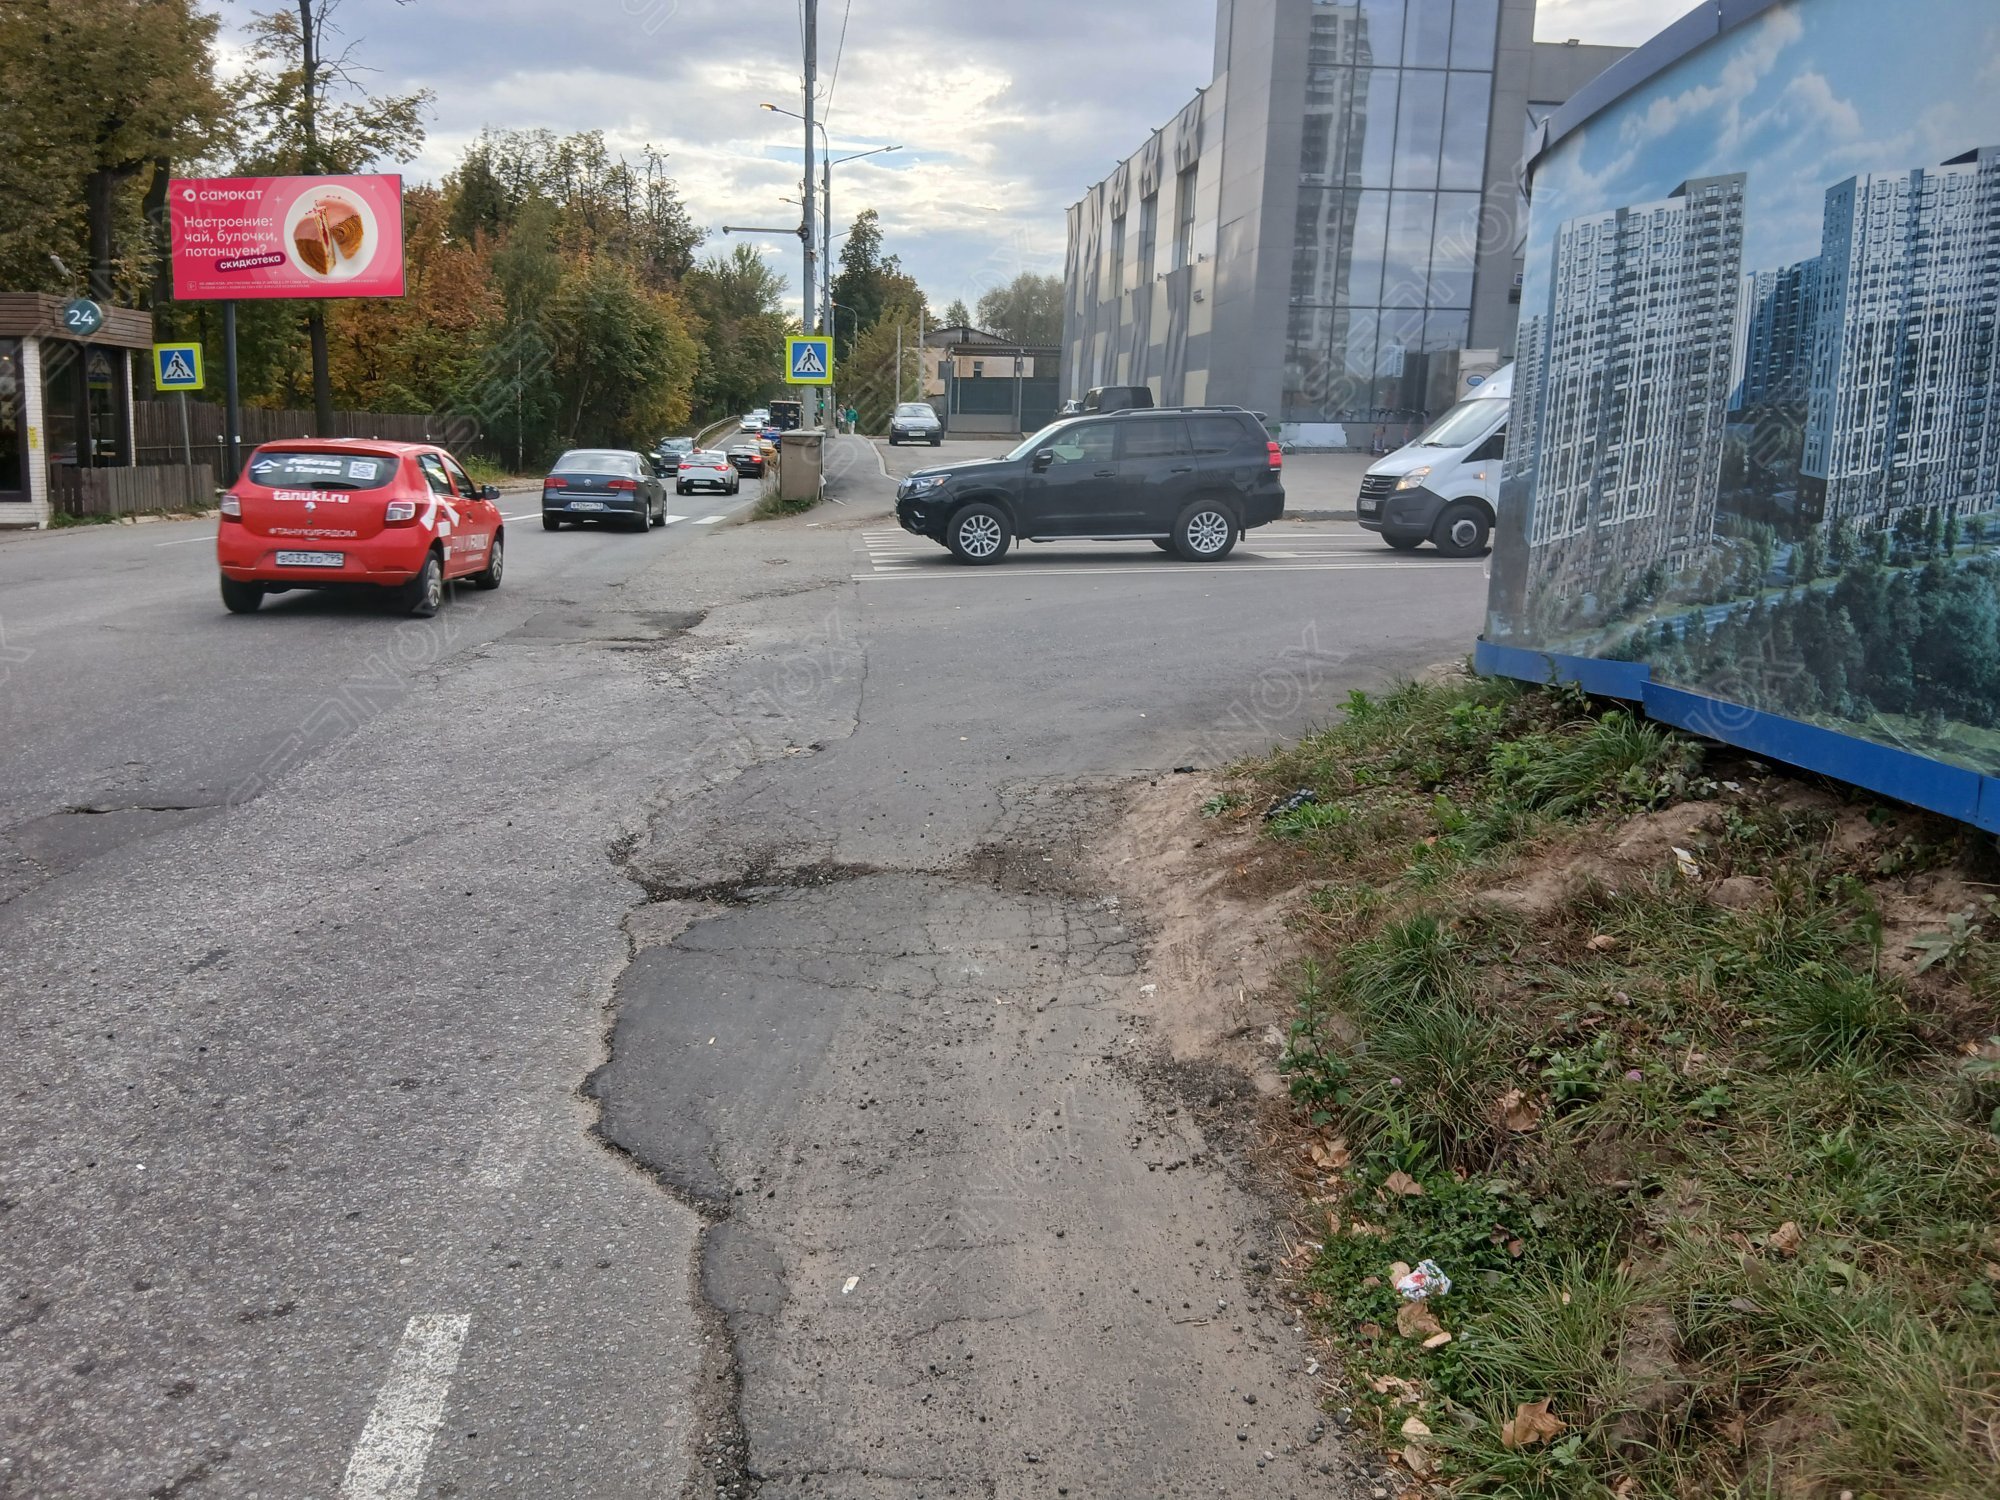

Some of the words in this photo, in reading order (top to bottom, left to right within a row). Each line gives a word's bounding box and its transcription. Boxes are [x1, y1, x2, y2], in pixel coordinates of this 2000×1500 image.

[199, 190, 263, 201] самокат
[183, 216, 273, 229] Настроение:
[184, 230, 214, 243] чай,
[216, 230, 278, 244] булочки,
[185, 244, 267, 259] потанцуем?
[220, 255, 281, 269] скидкотека
[68, 309, 95, 325] 24
[272, 490, 350, 504] tanuki.ru
